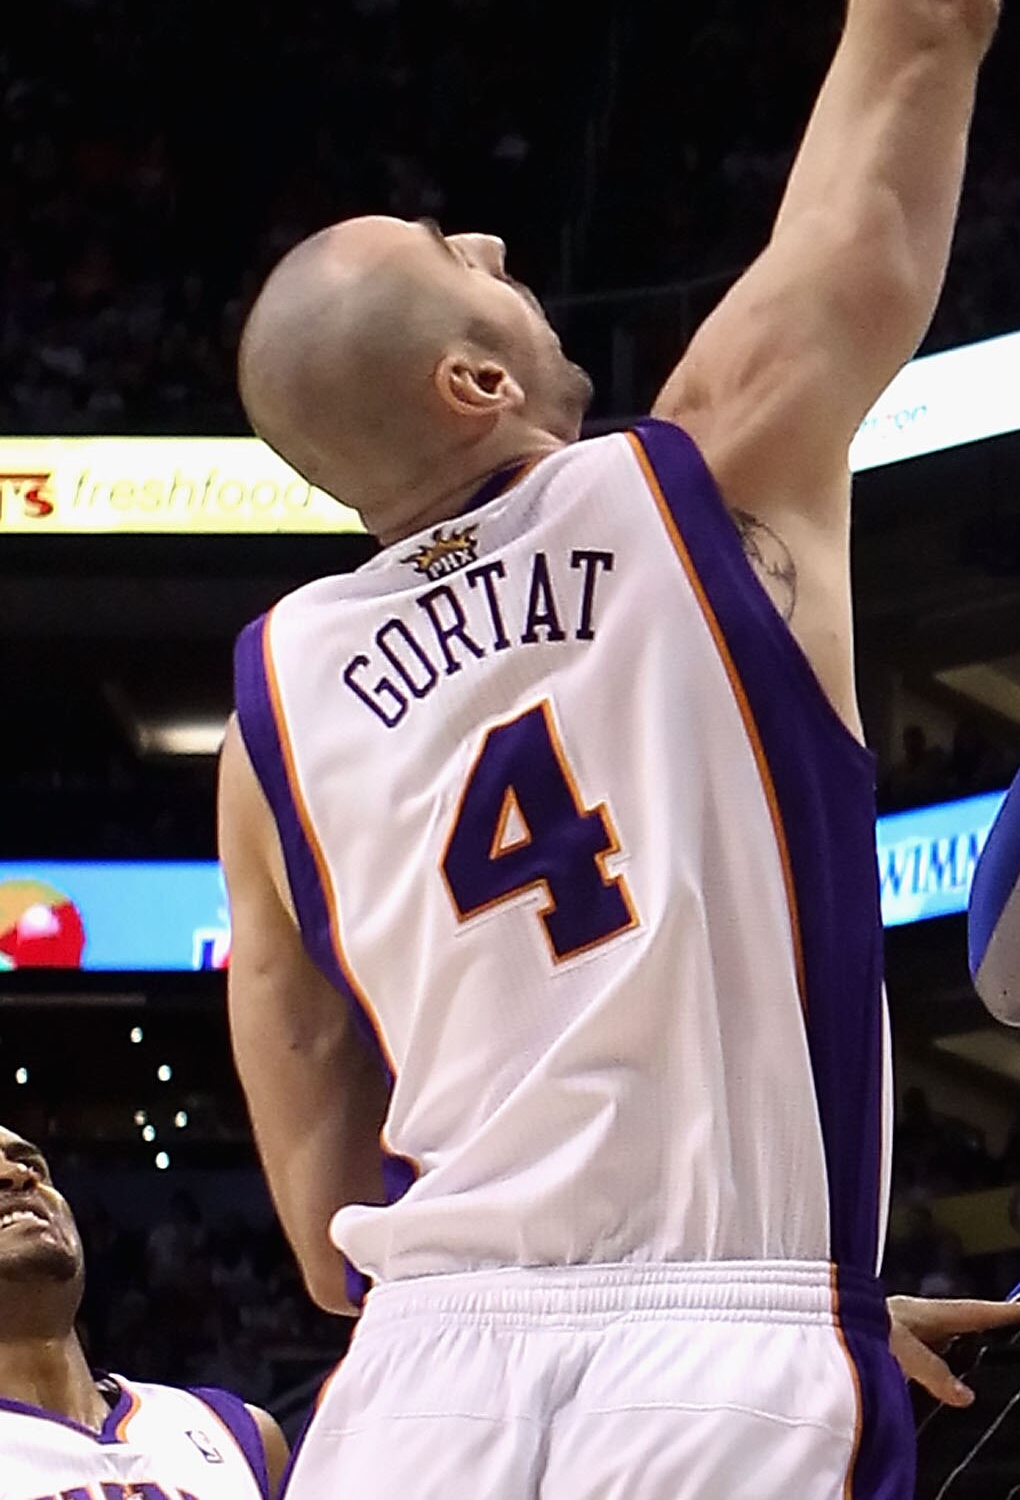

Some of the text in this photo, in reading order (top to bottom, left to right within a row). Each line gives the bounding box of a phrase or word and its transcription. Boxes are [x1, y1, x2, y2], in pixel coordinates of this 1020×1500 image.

[343, 550, 614, 728] GORTAT
[428, 548, 474, 579] PHX
[440, 699, 640, 965] 4
